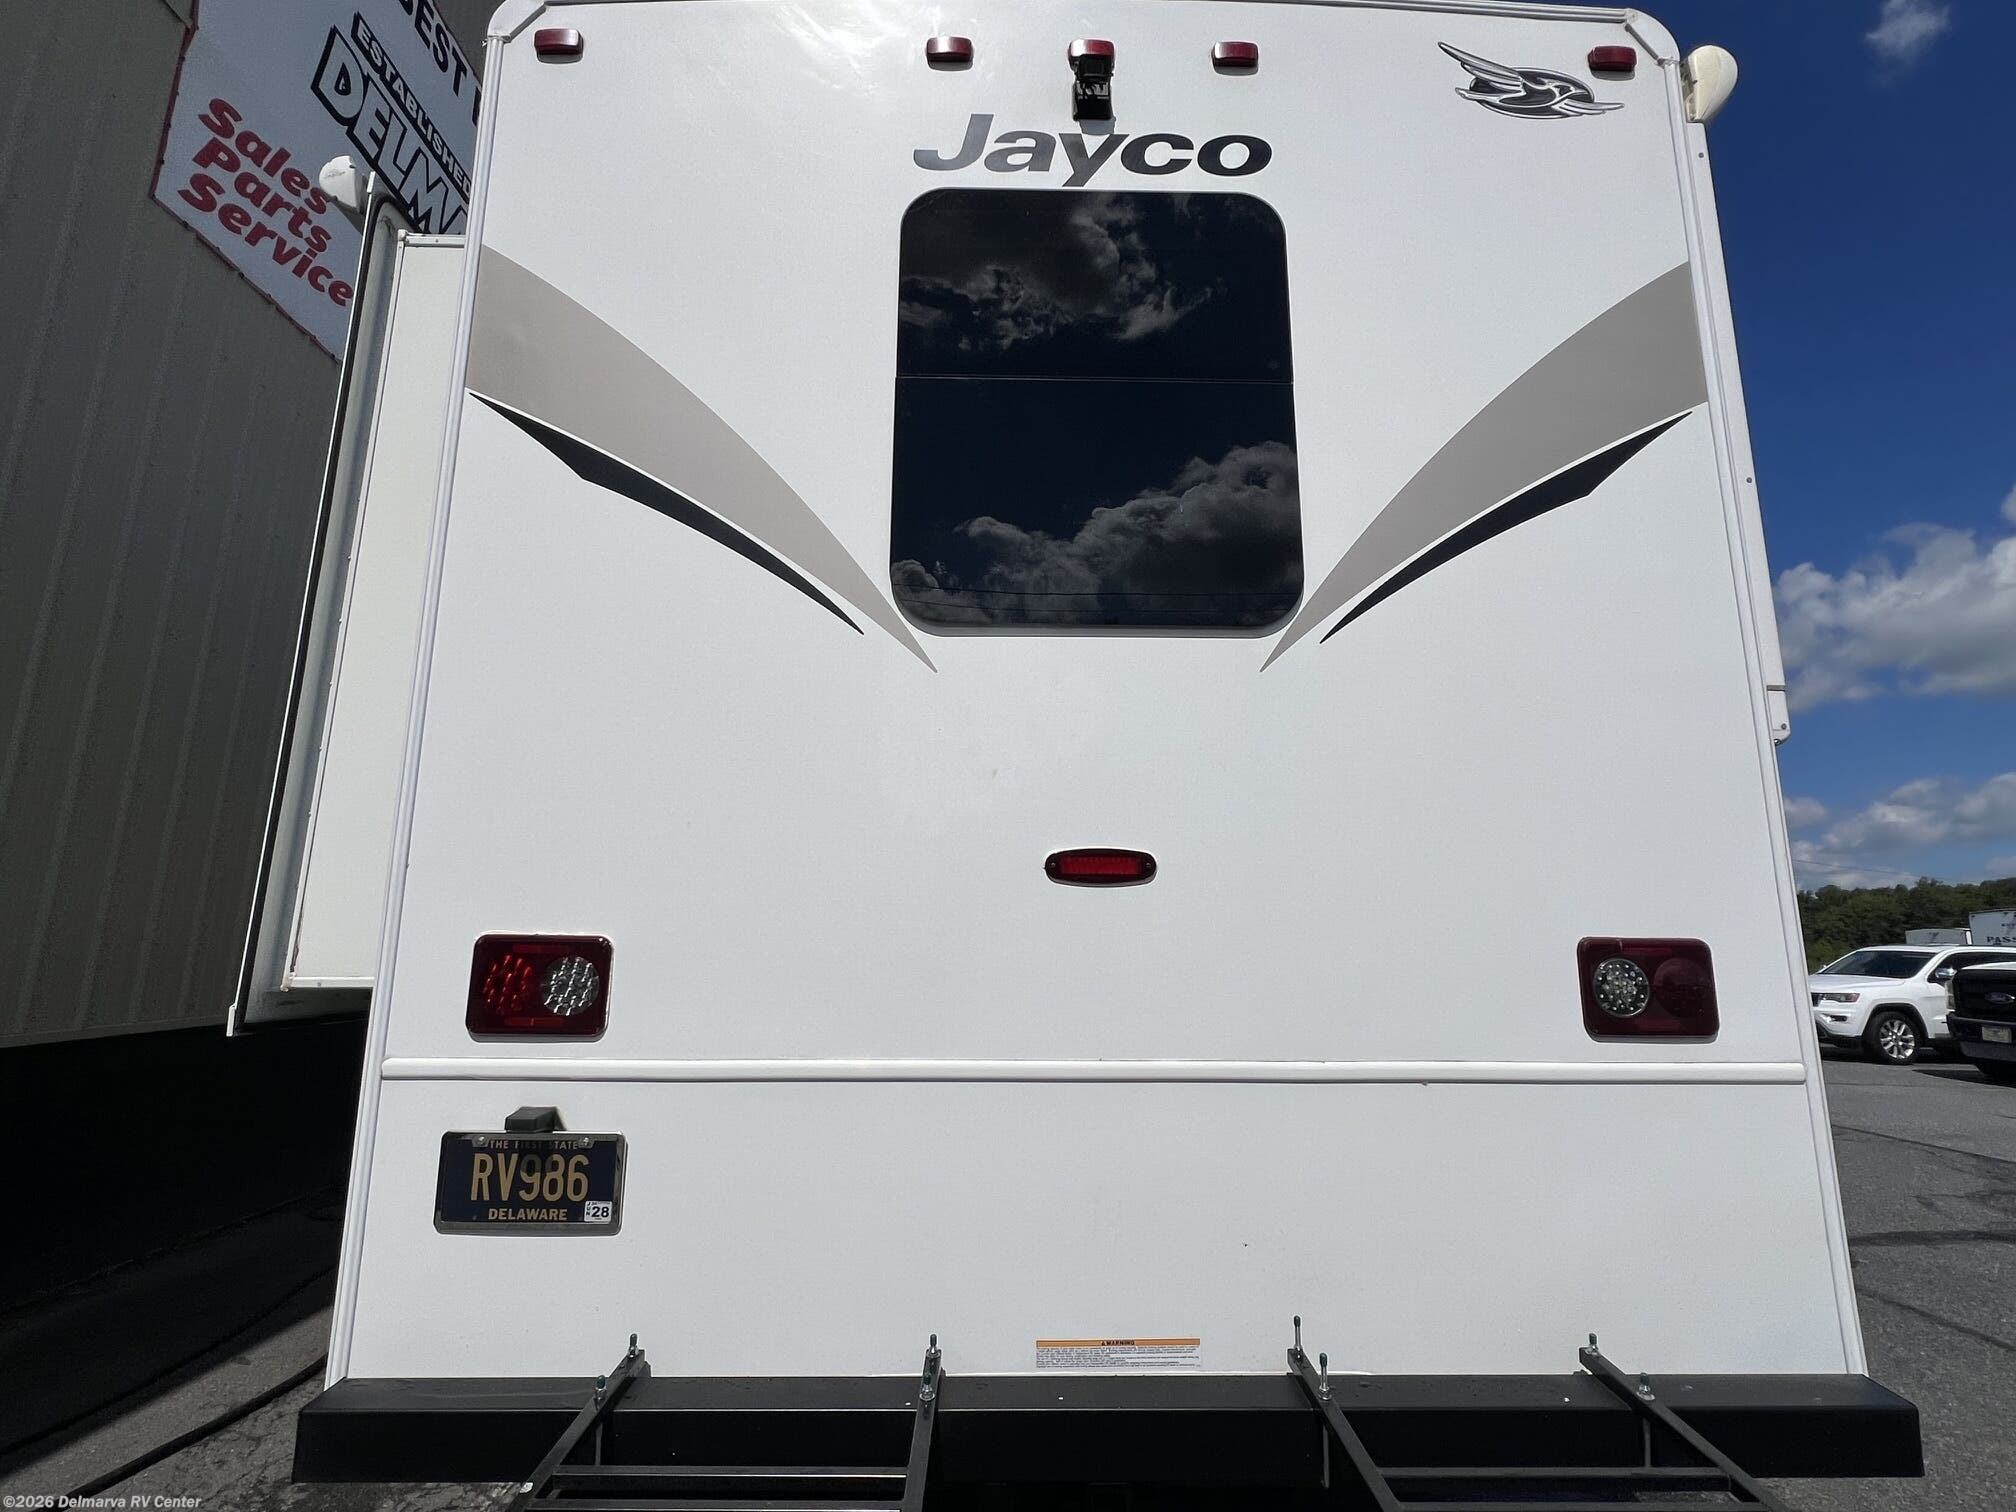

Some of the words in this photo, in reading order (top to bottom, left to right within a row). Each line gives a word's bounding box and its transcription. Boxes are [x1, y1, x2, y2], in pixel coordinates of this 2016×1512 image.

[398, 0, 467, 96] EST
[352, 12, 471, 202] ESTABLISHED
[198, 98, 331, 214] Sales
[913, 113, 1272, 187] Jayco
[192, 137, 331, 252] Parts
[177, 173, 354, 307] Service
[471, 1153, 590, 1202] RV986
[490, 1141, 509, 1149] THE
[549, 1141, 578, 1149] STATE
[488, 1208, 568, 1220] DELAWARE
[591, 1206, 610, 1218] 28
